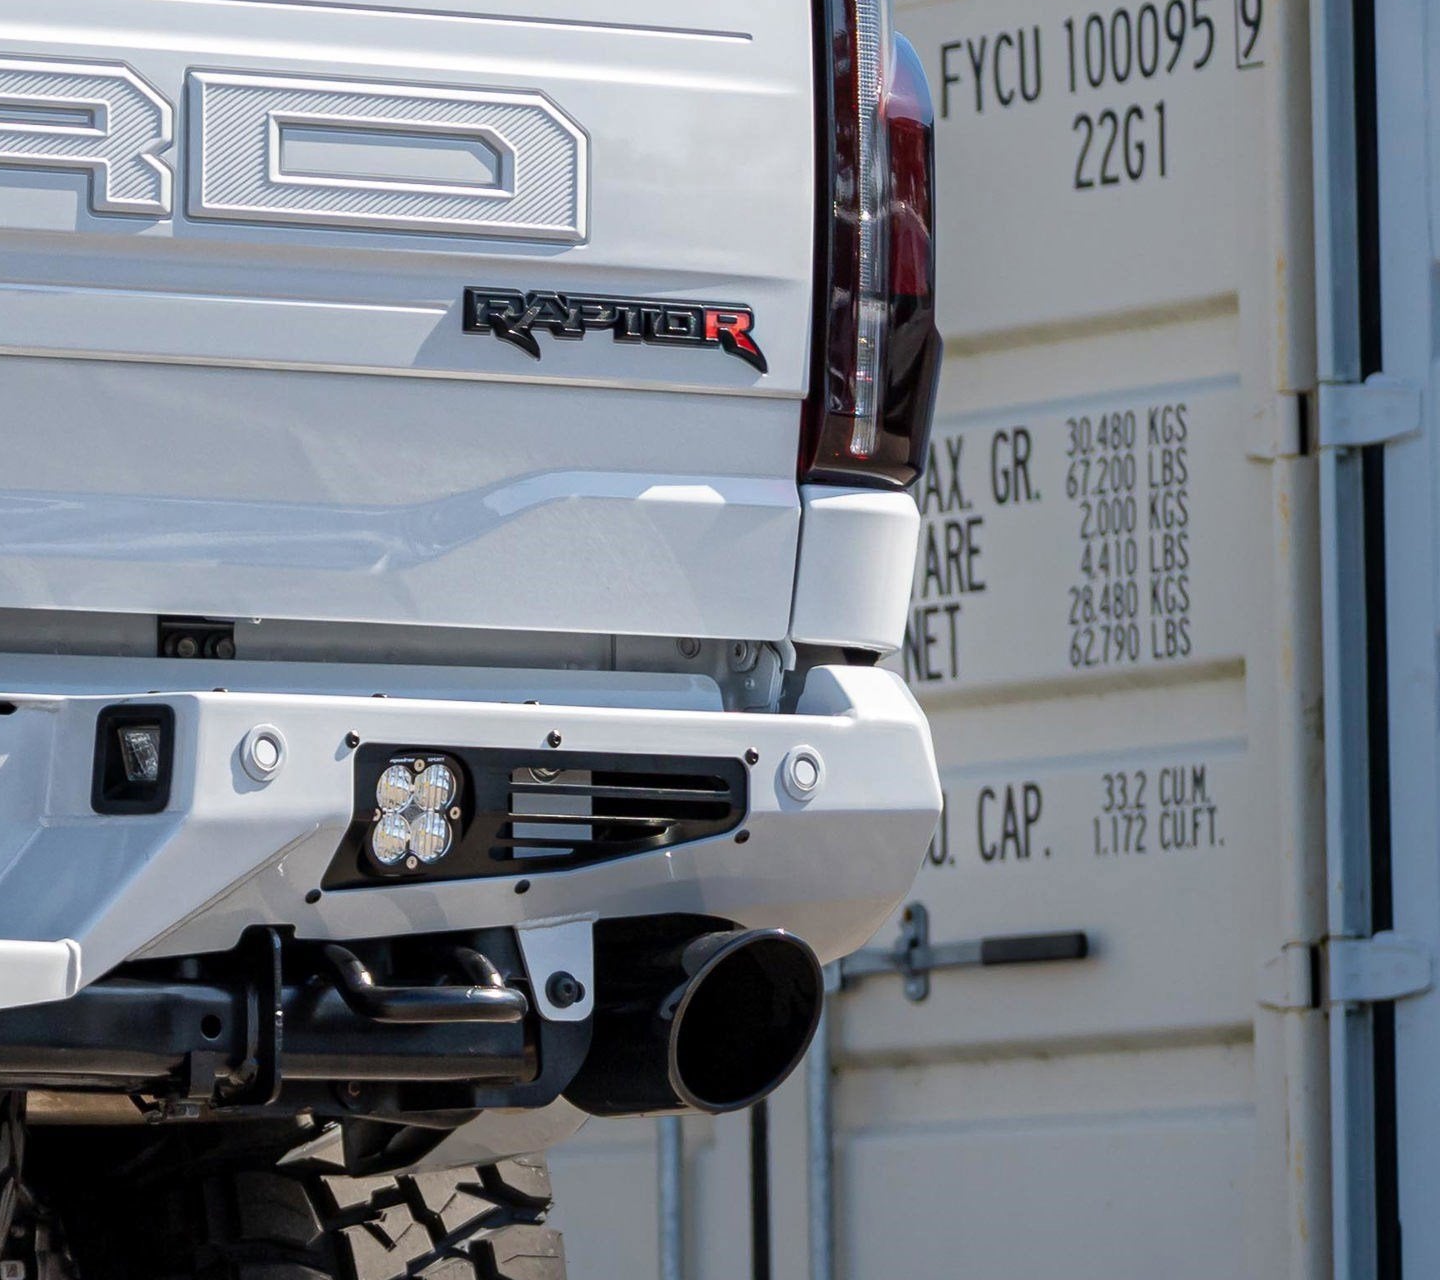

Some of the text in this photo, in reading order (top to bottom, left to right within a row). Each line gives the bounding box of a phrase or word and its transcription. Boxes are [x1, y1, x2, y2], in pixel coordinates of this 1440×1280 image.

[940, 26, 1042, 118] FYCU
[1073, 100, 1167, 190] 22G1
[462, 286, 769, 376] RAPTOR
[914, 403, 1188, 517] AX. GR. 30.480 KGS
[1148, 447, 1188, 489] LBS
[911, 489, 1188, 603] ARE 2.000 KGS
[1149, 531, 1189, 573] LBS
[1150, 575, 1190, 615] KGS
[1151, 617, 1191, 659] LBS
[923, 791, 956, 866] U.
[978, 783, 1051, 862] CAP.
[1102, 771, 1148, 812] 33.2
